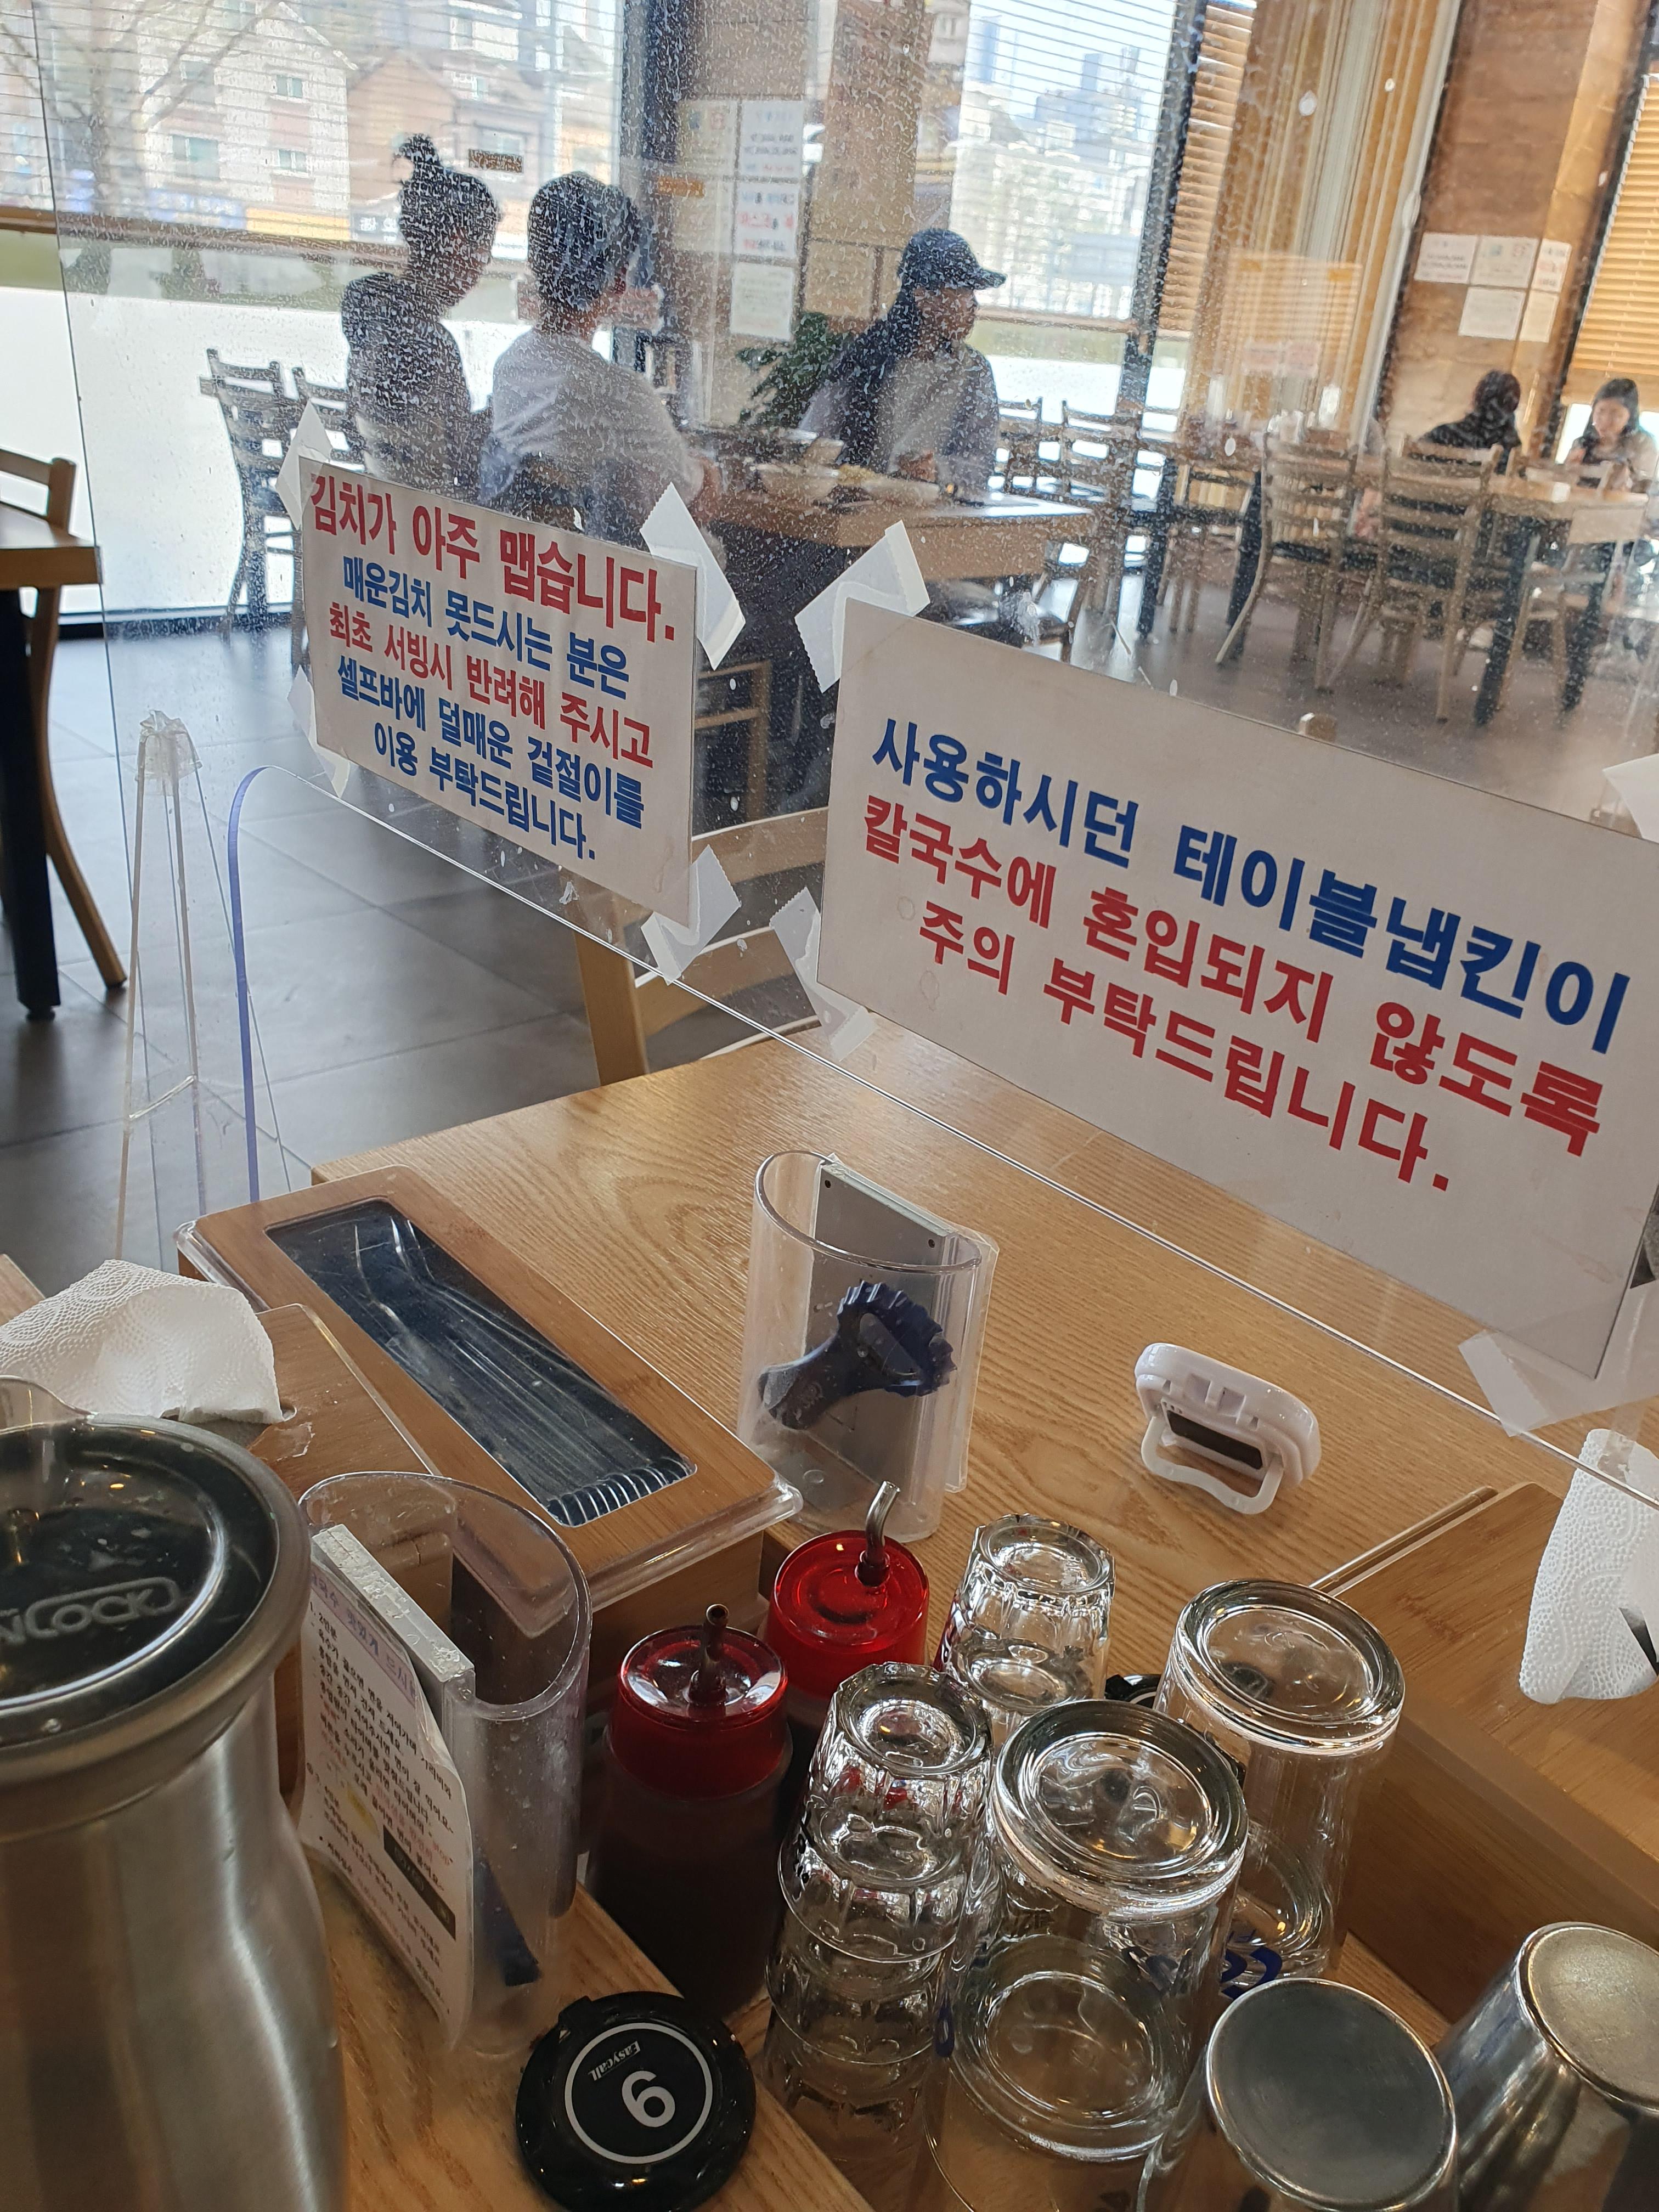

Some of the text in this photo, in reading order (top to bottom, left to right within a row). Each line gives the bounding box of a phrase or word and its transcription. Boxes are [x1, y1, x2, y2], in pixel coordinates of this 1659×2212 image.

[310, 472, 674, 642] 김치가 아주 맵습니다.
[343, 556, 629, 700] 매운김치 못드시는 분은
[330, 602, 653, 768] 최초 서빙시 반려해 주시고
[337, 655, 644, 830] 셀프바에 덜매운 겉절이를
[374, 723, 595, 860] 이용 부탁드립니다.
[872, 719, 1630, 1054] 사용하시던 테이블냅킨이
[864, 795, 1603, 1157] 칼국수에 혼입되지 않도록
[919, 901, 1449, 1192] 주의 부탁드립니다.
[588, 2041, 641, 2081] Easycall
